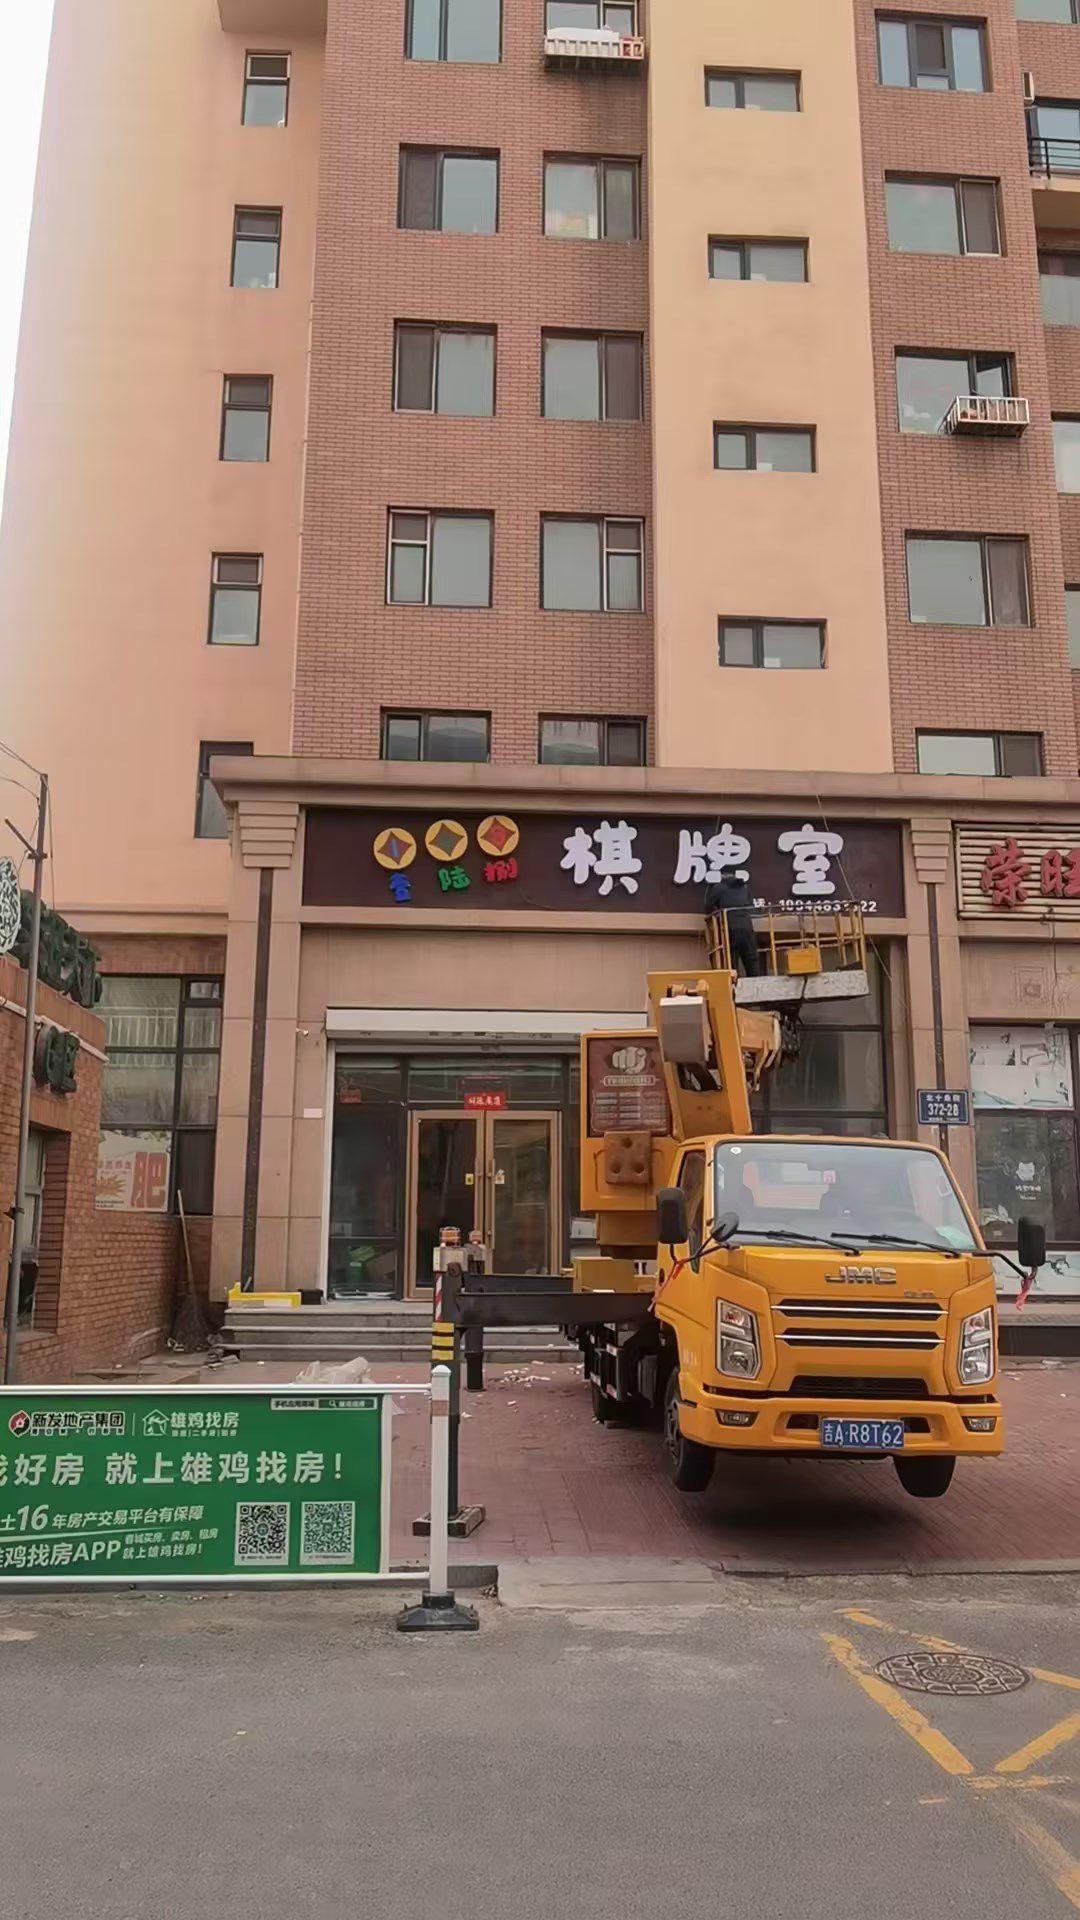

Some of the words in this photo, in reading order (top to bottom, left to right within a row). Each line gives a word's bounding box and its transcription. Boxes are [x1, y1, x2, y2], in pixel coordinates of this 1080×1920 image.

[559, 820, 844, 896] 棋牌室
[928, 1103, 959, 1116] 372-28
[825, 1266, 897, 1285] JMC
[32, 1411, 125, 1428] 新发地产集团
[170, 1412, 239, 1429] 雄鸡找房
[106, 1452, 343, 1484] 就上雄鸡找房！
